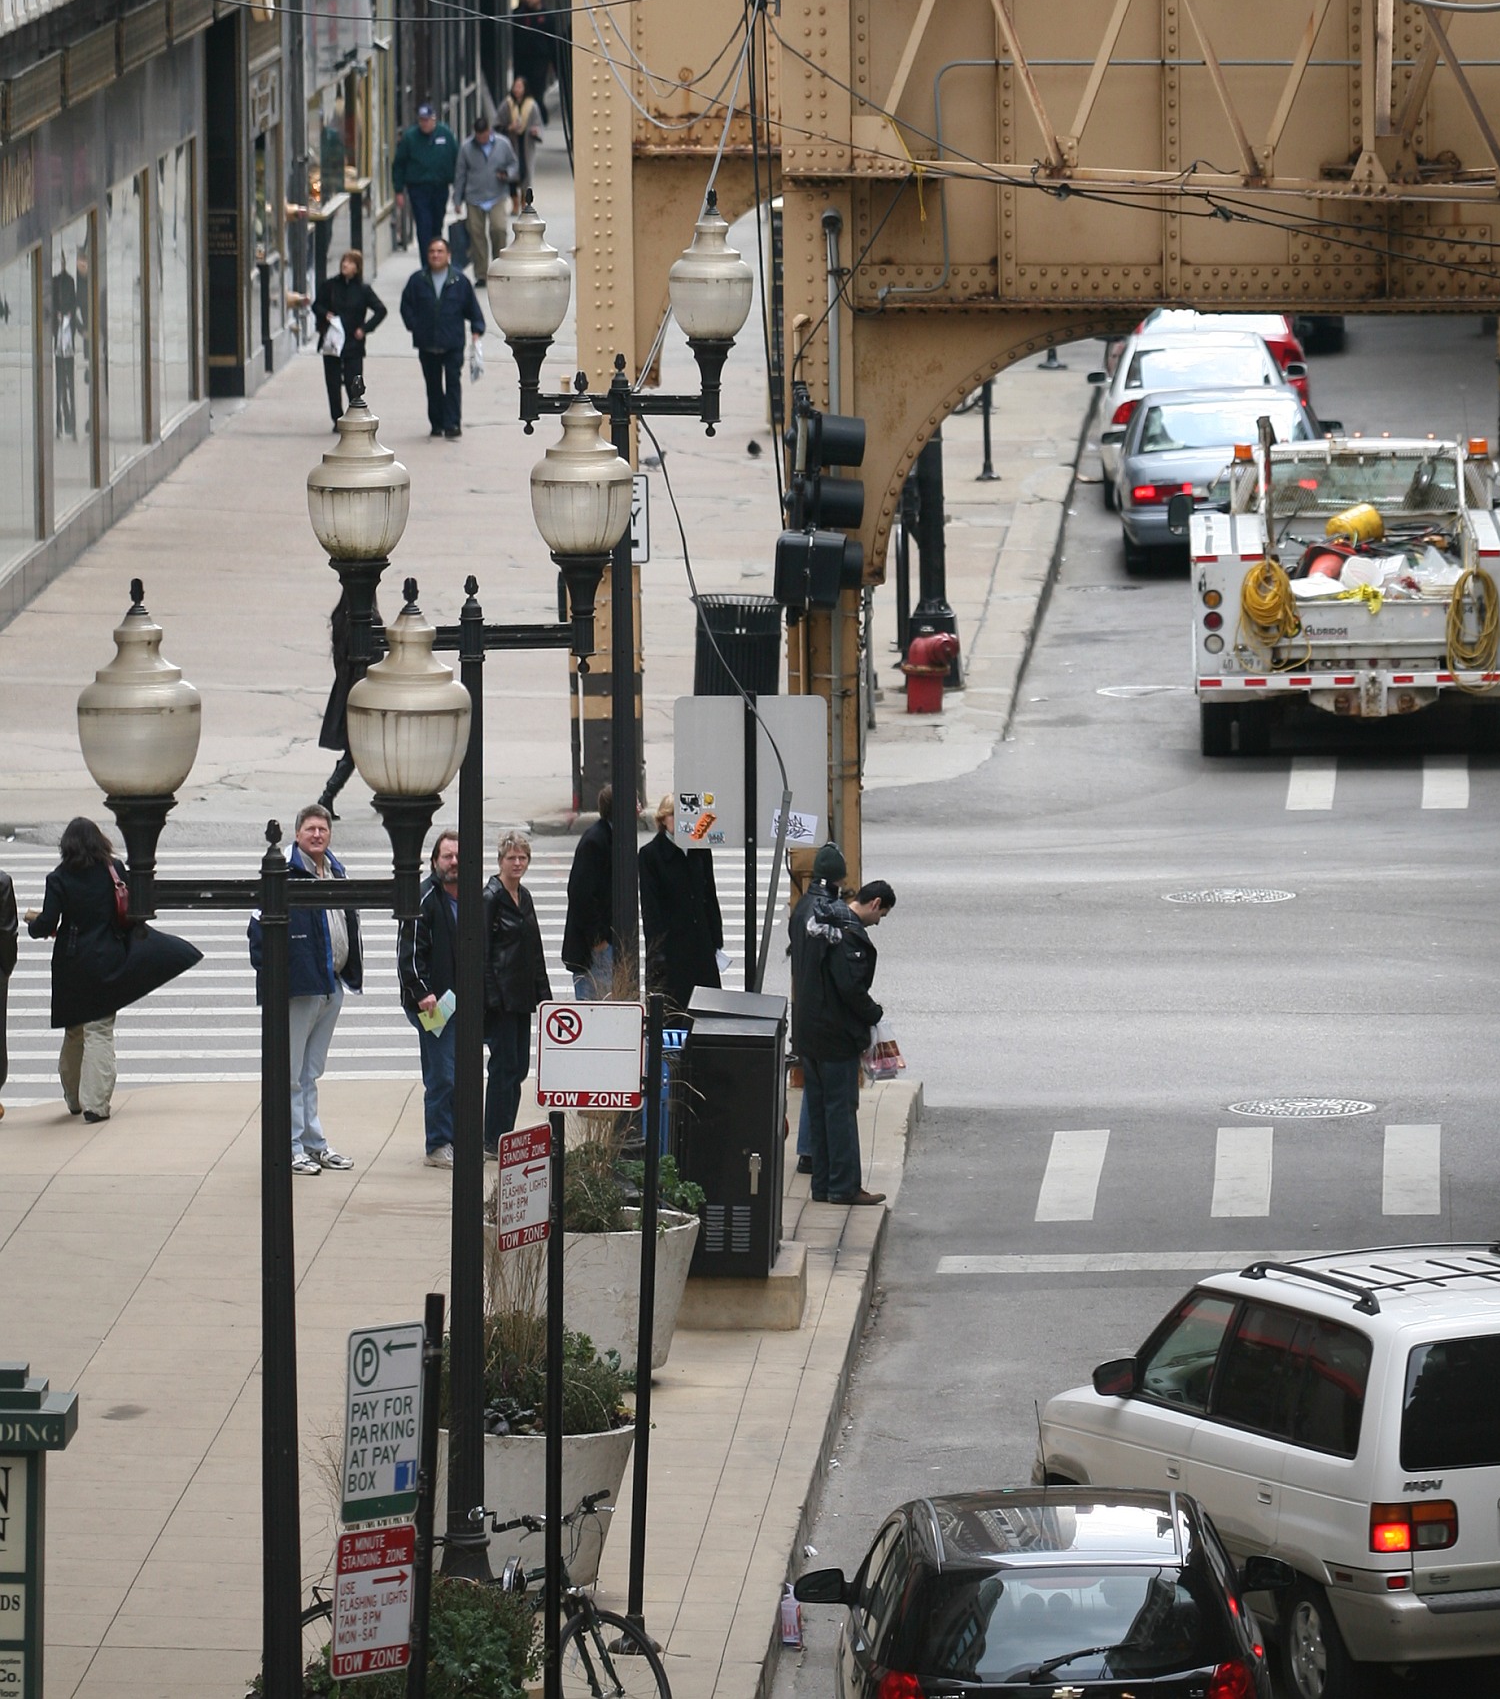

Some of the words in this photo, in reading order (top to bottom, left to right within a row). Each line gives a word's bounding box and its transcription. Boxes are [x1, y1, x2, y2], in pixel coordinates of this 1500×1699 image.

[543, 1092, 579, 1106] TOW
[587, 1093, 633, 1107] ZONE
[502, 1148, 529, 1165] STANDING
[531, 1143, 546, 1158] ZONE
[502, 1174, 513, 1187] USE
[502, 1183, 528, 1200] FLASHING
[529, 1177, 548, 1193] LIGHTS
[502, 1231, 519, 1250] TOW
[523, 1224, 546, 1243] ZONE
[351, 1400, 378, 1423] PAY
[384, 1396, 413, 1418] FOR
[350, 1418, 415, 1446] PARKING
[349, 1448, 368, 1470] AT
[372, 1444, 400, 1467] PAY
[348, 1470, 377, 1493] BOX
[342, 1539, 351, 1554] 15
[355, 1534, 386, 1553] MINUTE
[341, 1551, 382, 1570] STANDING
[385, 1547, 408, 1564] ZONE
[340, 1581, 356, 1596] USE
[339, 1594, 377, 1612] FLASHING
[381, 1589, 408, 1607] LIGHTS
[337, 1653, 364, 1675] TOW
[369, 1647, 404, 1670] ZONE
